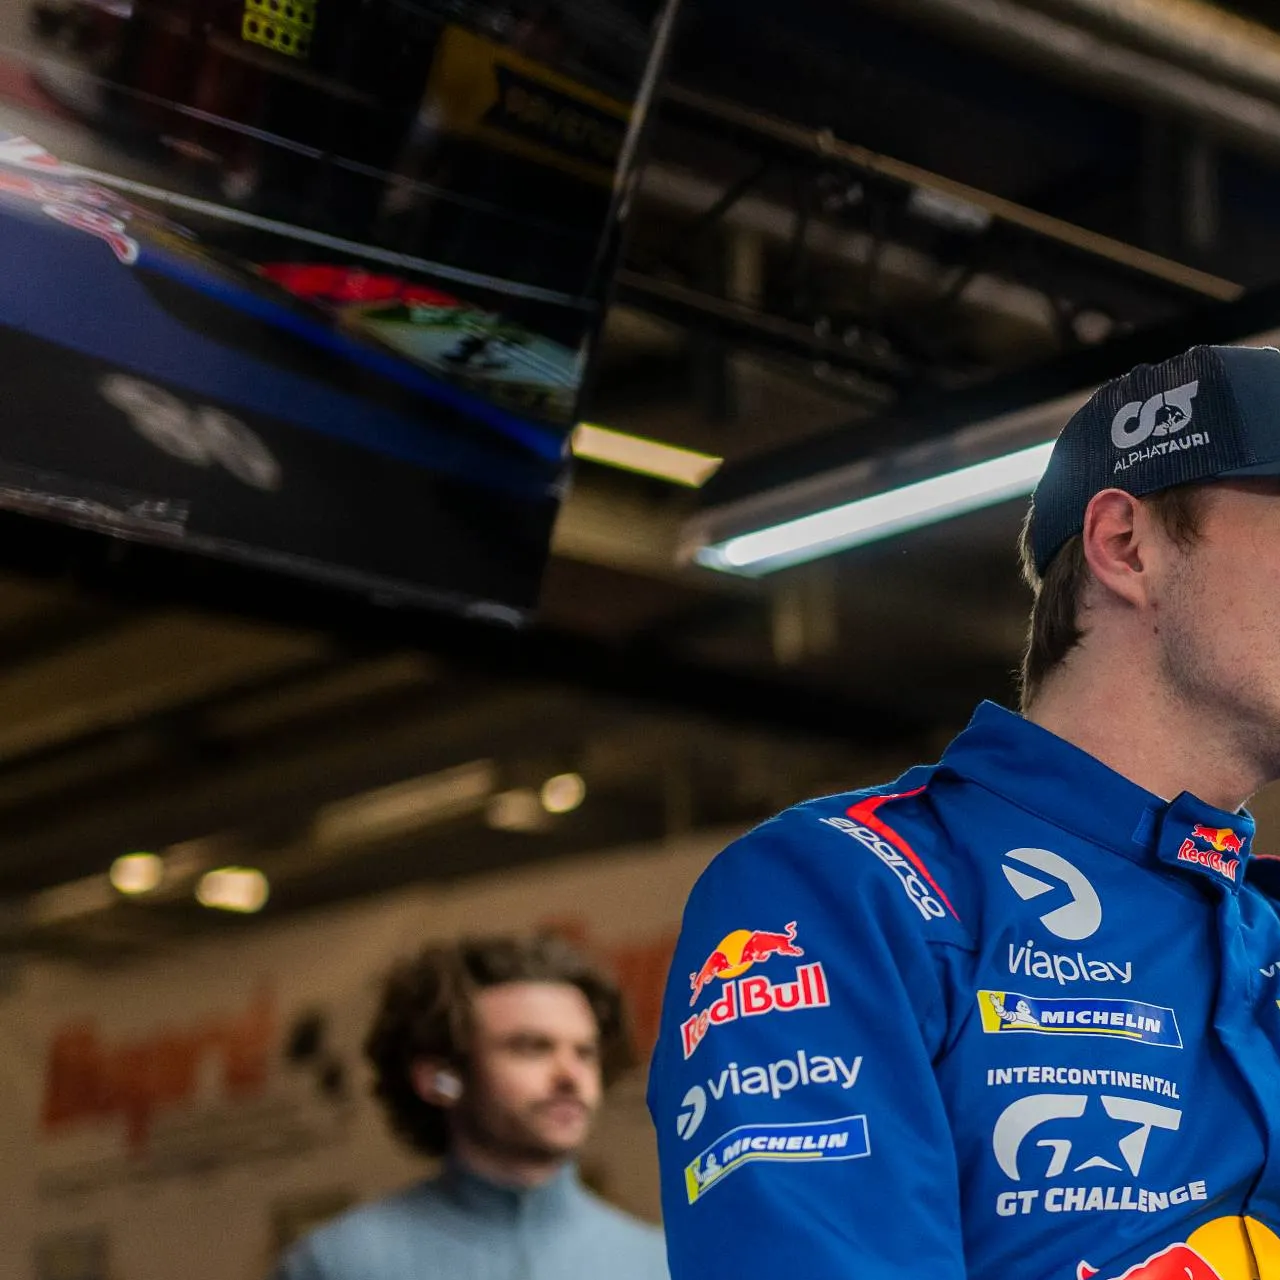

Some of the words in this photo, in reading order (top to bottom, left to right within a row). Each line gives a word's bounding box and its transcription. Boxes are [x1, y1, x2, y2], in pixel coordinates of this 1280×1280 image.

[1113, 431, 1210, 474] ALPHATAURI
[819, 817, 946, 920] sparco
[1178, 838, 1212, 867] Red
[1210, 850, 1239, 882] Bull
[1008, 940, 1133, 985] viaplay
[680, 980, 739, 1060] Red
[738, 961, 831, 1018] Bull
[1040, 1009, 1161, 1034] MICHELIN
[707, 1050, 863, 1099] viaplay
[987, 1066, 1180, 1099] INTERCONTINENTAL
[722, 1131, 848, 1162] MICHELIN
[996, 1187, 1039, 1216] GT
[1044, 1180, 1207, 1213] CHALLENGE
